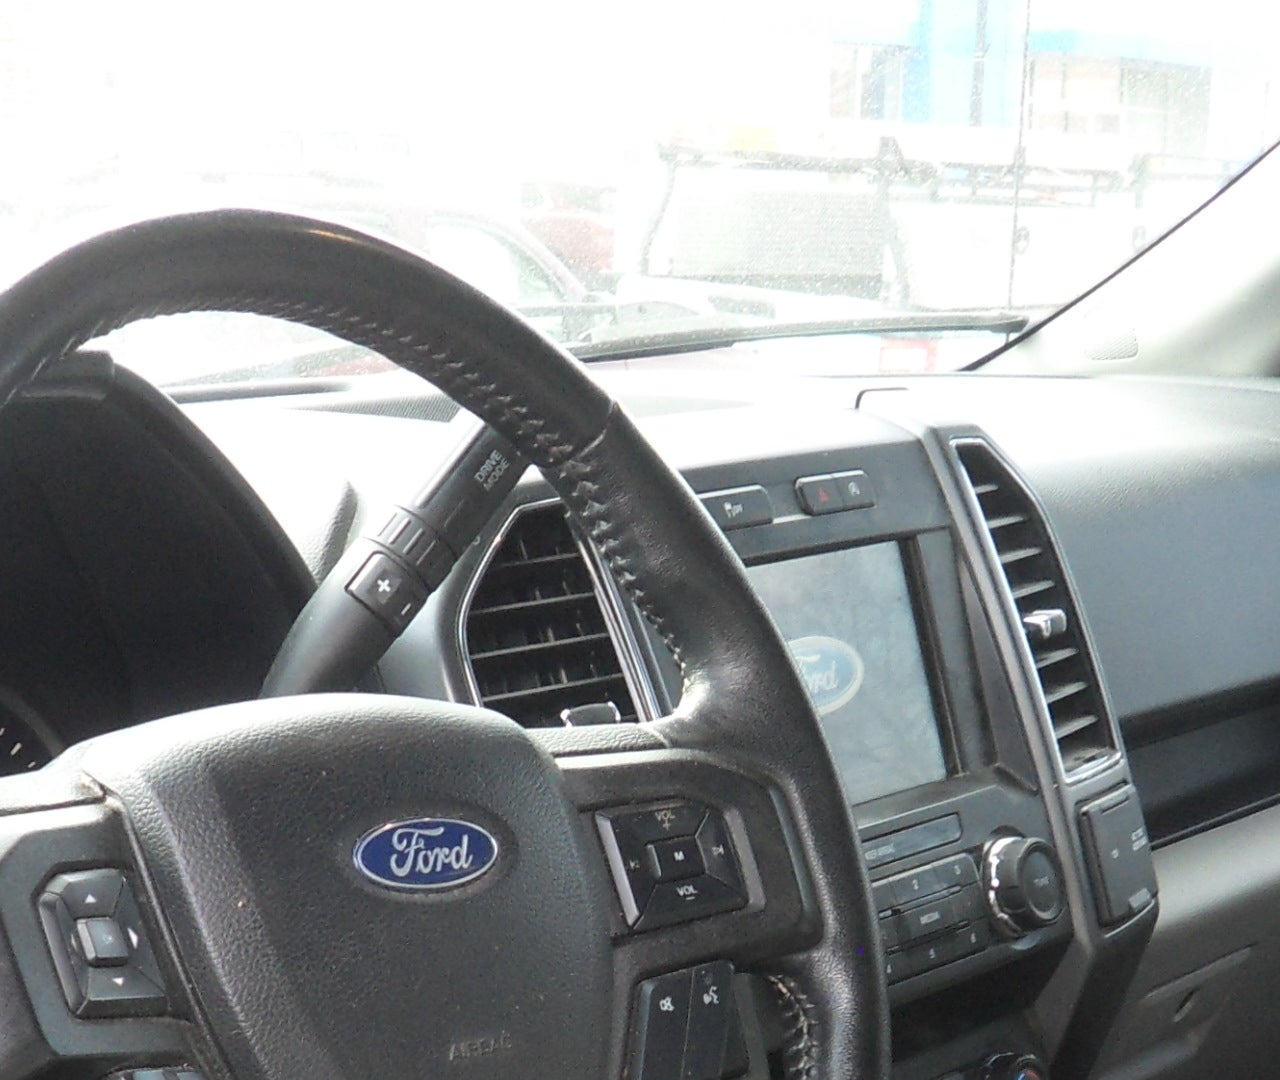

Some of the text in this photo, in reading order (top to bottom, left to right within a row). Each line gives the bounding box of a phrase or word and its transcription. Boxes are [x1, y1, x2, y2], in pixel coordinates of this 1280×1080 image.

[474, 449, 502, 482] DRIVE
[483, 457, 510, 491] MODE
[654, 810, 676, 821] VOL
[390, 826, 473, 877] Ford
[673, 851, 685, 861] M
[911, 879, 920, 890] 2
[676, 885, 699, 897] VOL
